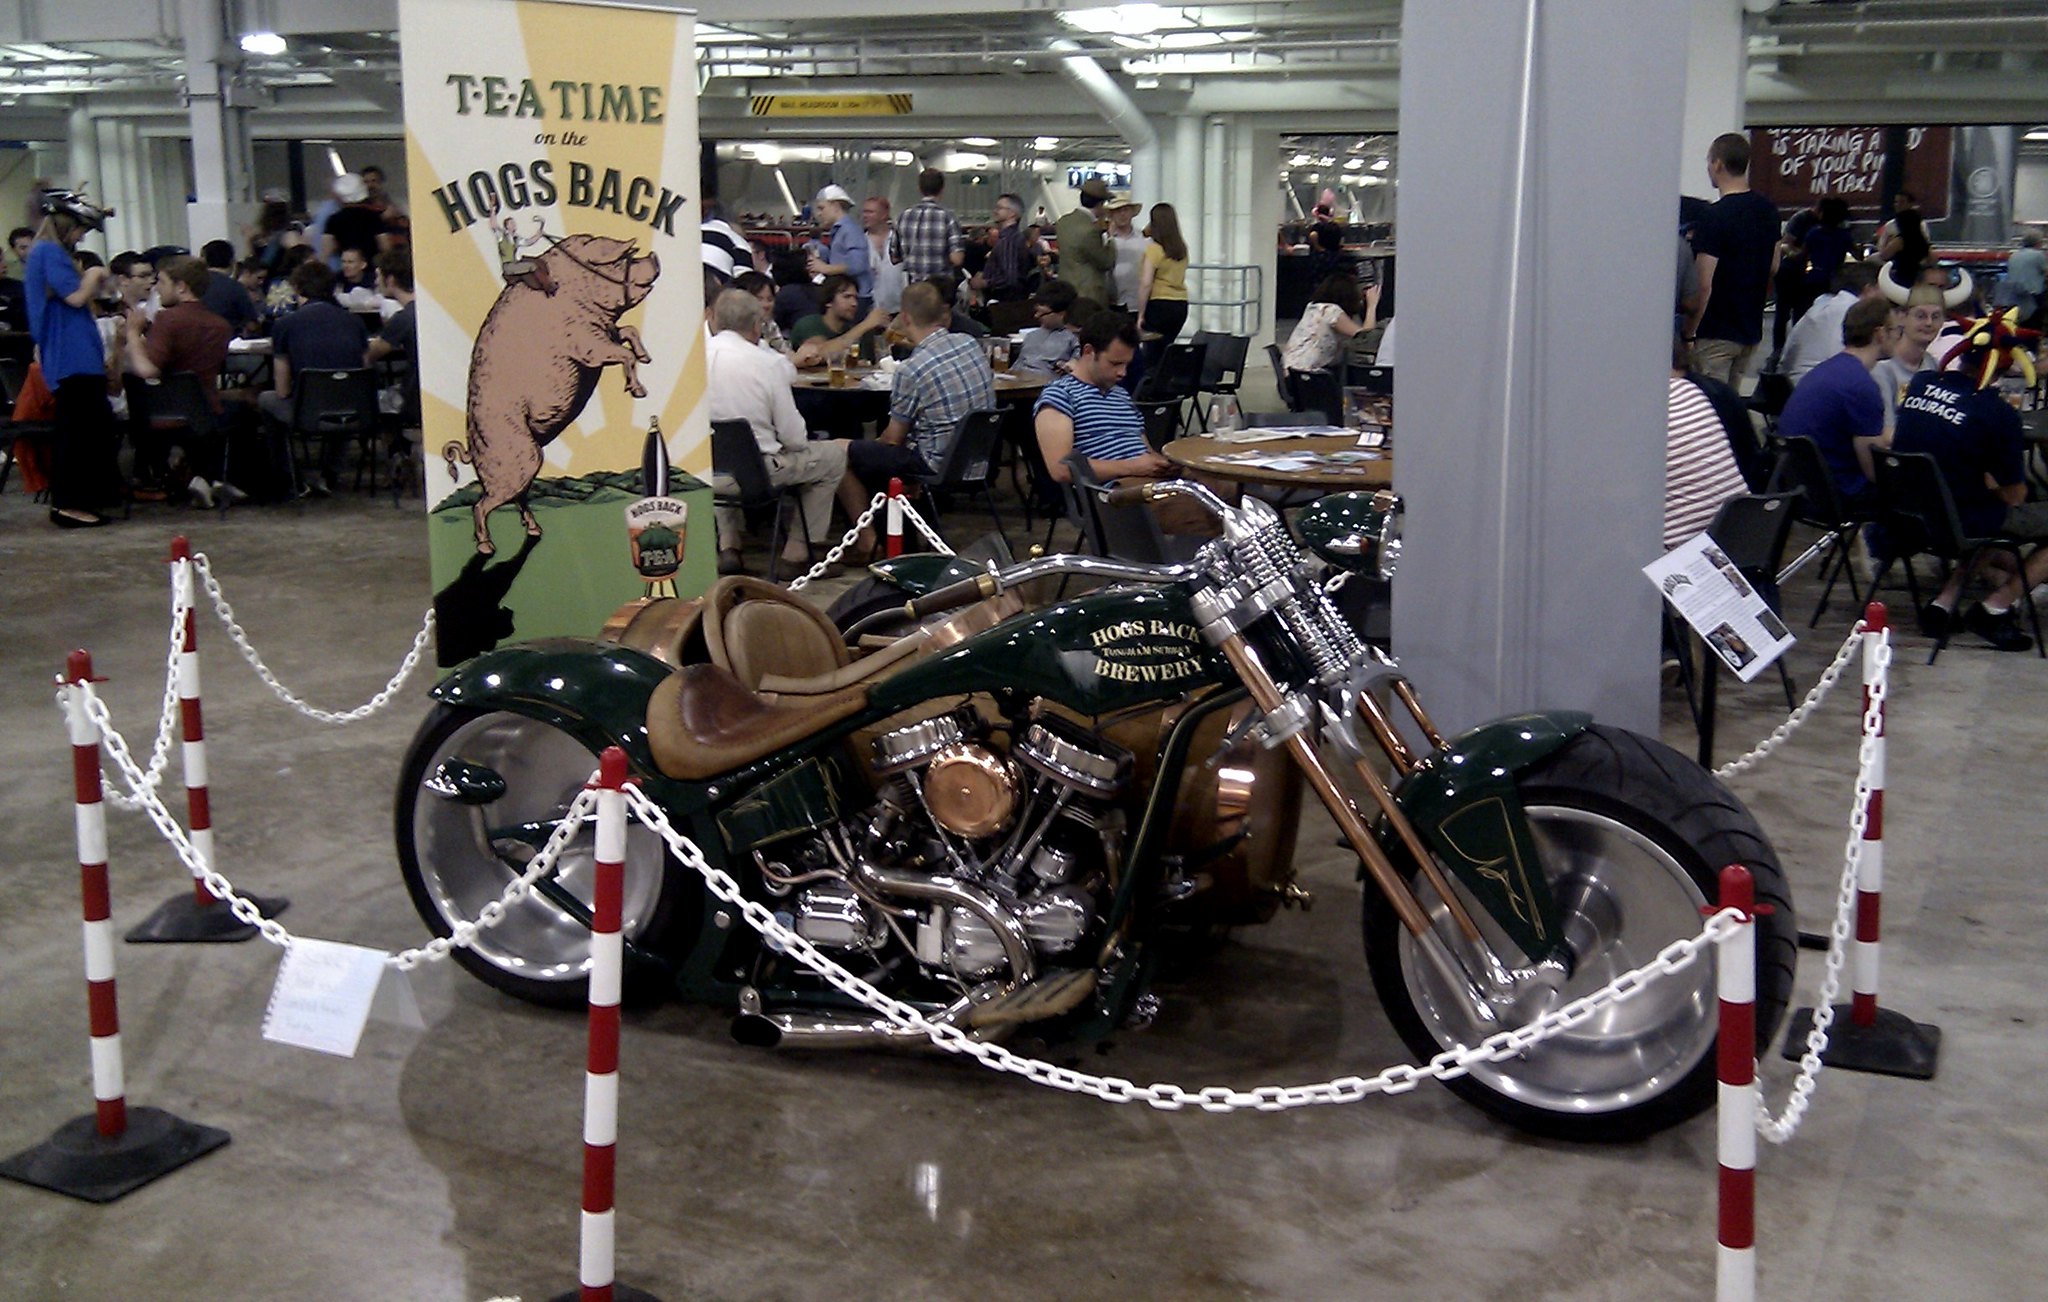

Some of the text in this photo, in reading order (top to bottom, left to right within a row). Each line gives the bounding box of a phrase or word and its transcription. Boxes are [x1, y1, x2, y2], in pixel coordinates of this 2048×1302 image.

[550, 80, 664, 124] TIME
[534, 131, 587, 146] on the
[1772, 136, 1790, 155] IS
[1793, 131, 1864, 155] TAKING
[1868, 132, 1881, 151] A
[1780, 155, 1806, 176] OF
[1811, 151, 1859, 177] YOUR
[1810, 175, 1829, 194] IN
[431, 160, 687, 237] HOGS BACK
[1923, 384, 1960, 404] TAKE
[1904, 396, 1966, 425] COURAGE
[657, 501, 682, 515] BACK
[1090, 619, 1200, 647] HOGS BACK
[1094, 656, 1202, 682] BREWERY
